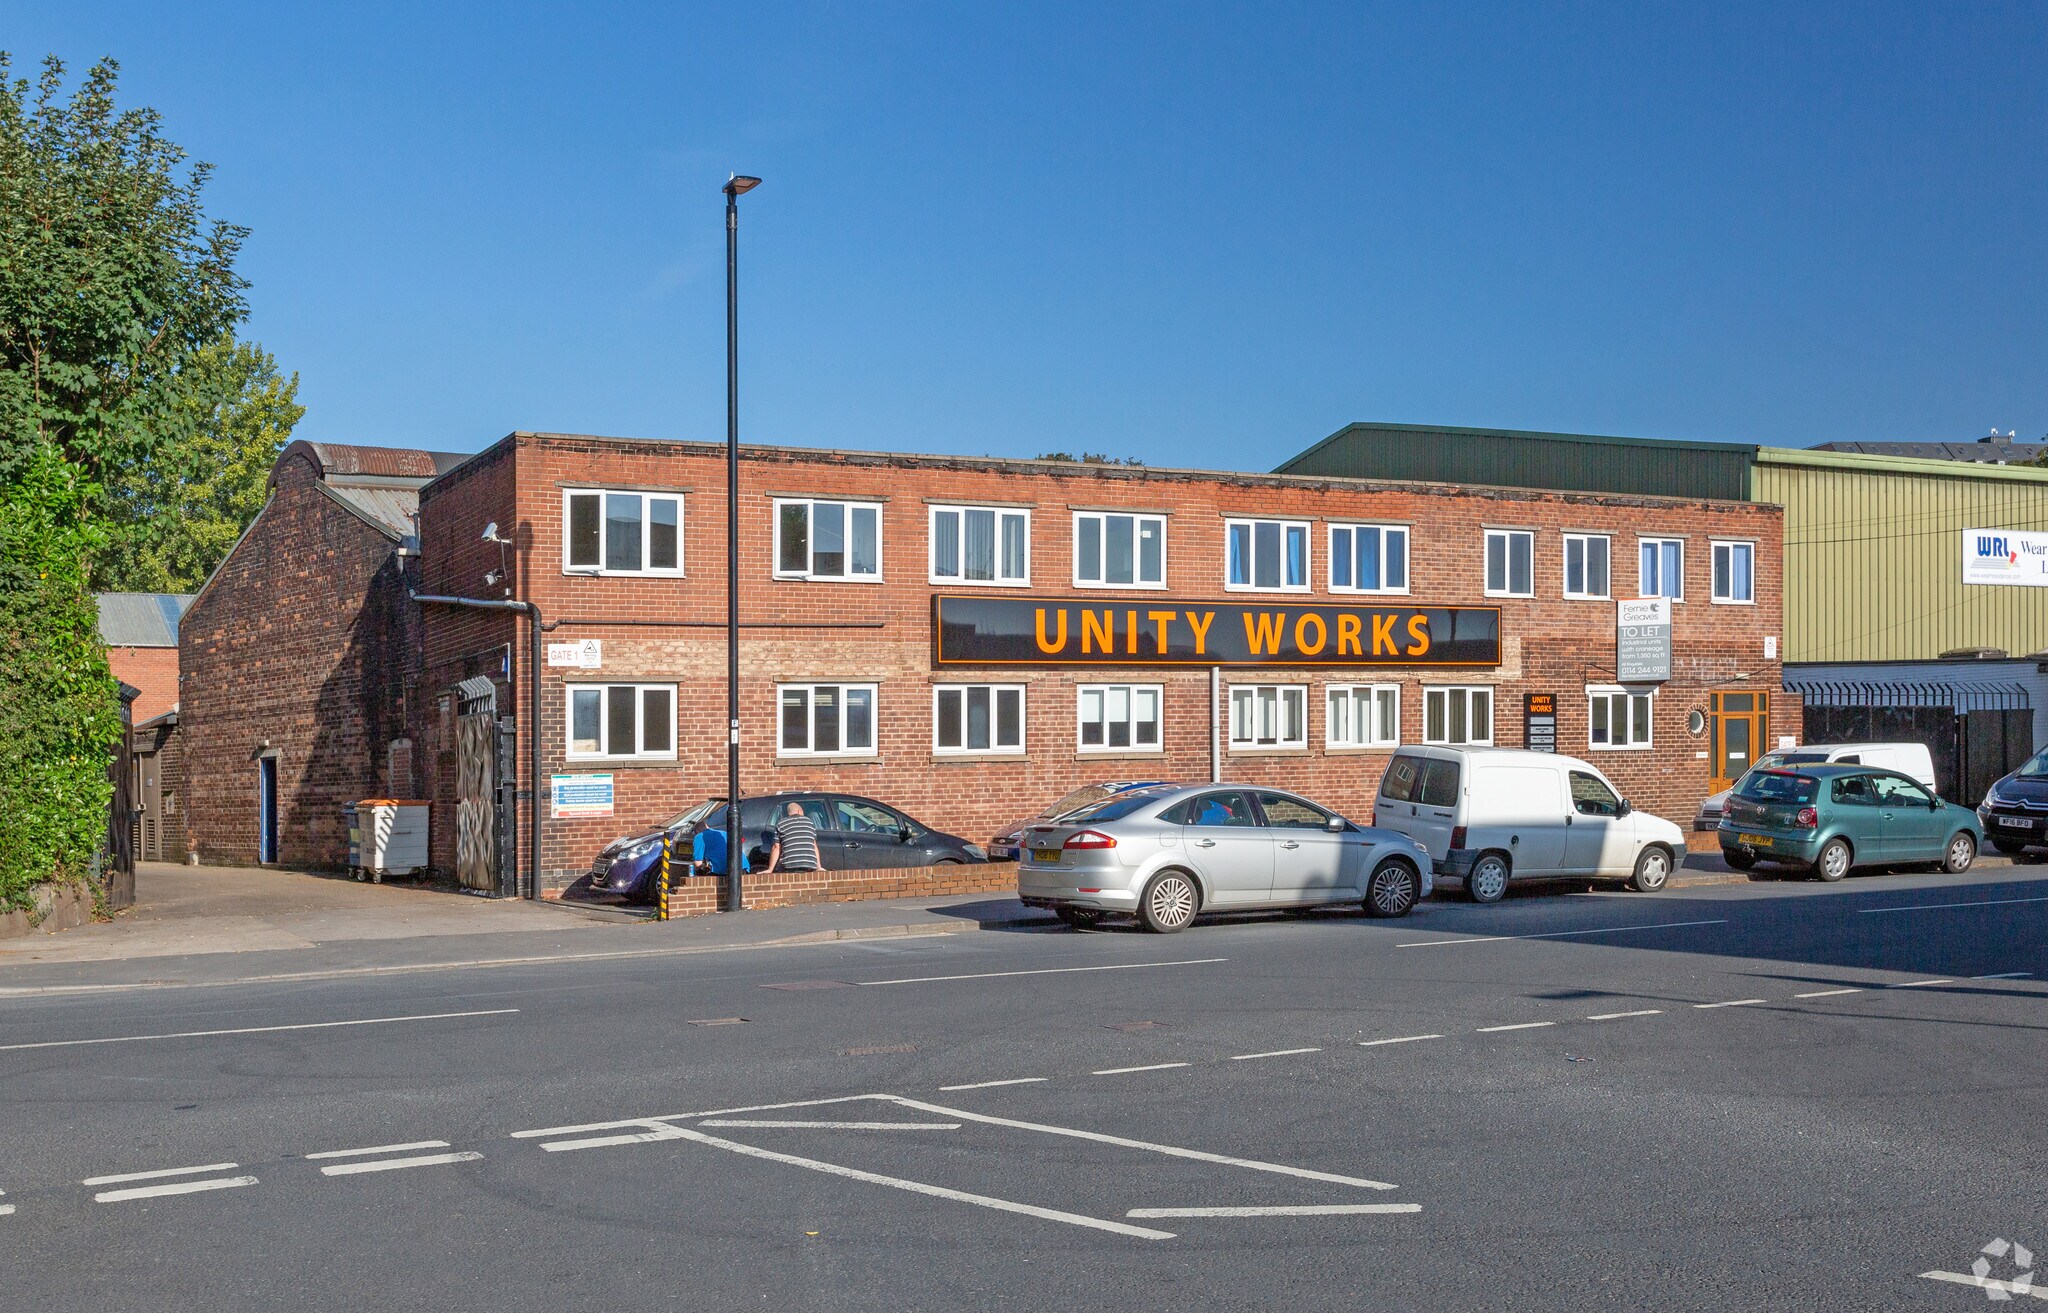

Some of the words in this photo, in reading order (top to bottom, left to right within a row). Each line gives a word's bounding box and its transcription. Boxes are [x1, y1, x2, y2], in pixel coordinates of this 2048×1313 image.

[1977, 536, 2009, 557] WRL
[2021, 541, 2048, 555] Wear
[1623, 604, 1649, 613] Fernie
[1623, 612, 1659, 621] Greaves
[1035, 608, 1216, 655] UNITY
[1242, 612, 1430, 656] WORKS
[1621, 626, 1638, 638] TO
[1641, 626, 1660, 637] LET
[550, 650, 572, 660] GATE
[1637, 666, 1651, 674] 244
[1652, 665, 1667, 673] 9121
[1531, 696, 1551, 704] UNITY
[1530, 704, 1553, 713] WORKS
